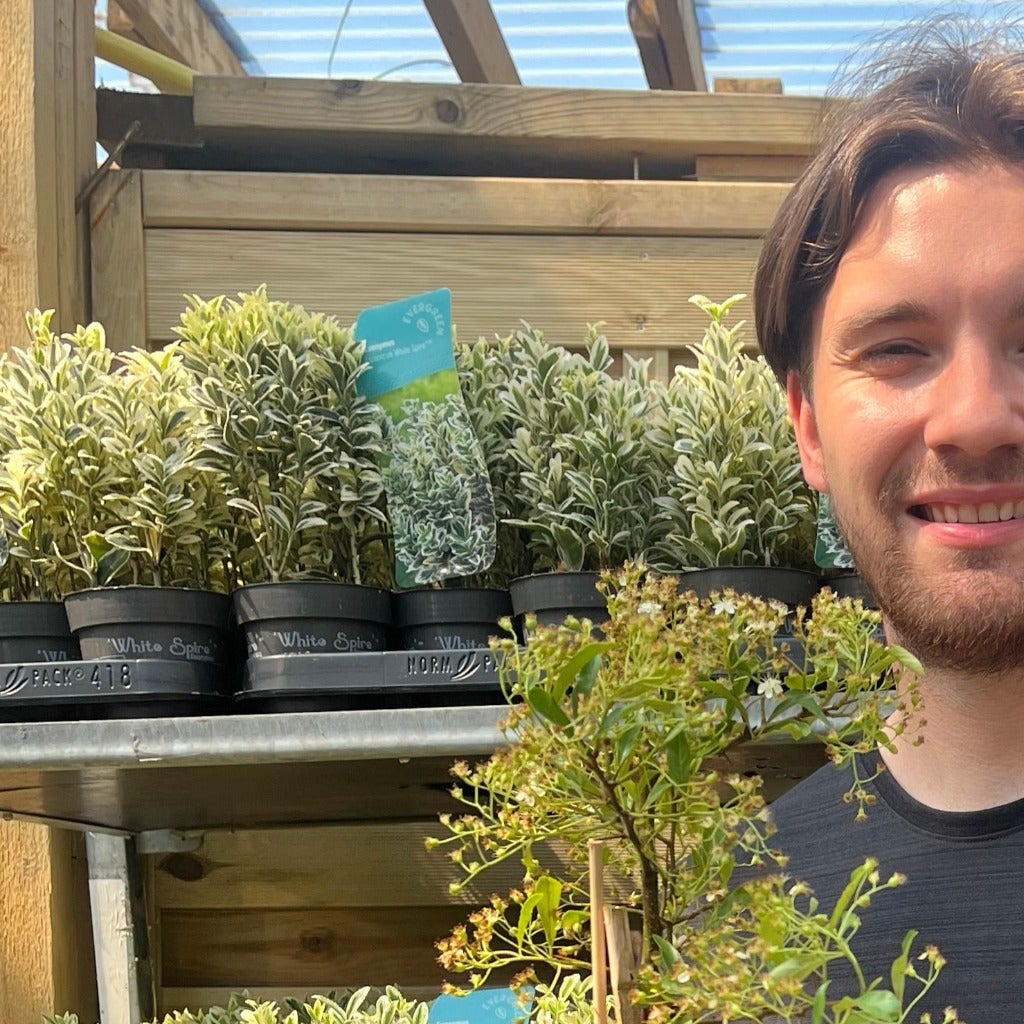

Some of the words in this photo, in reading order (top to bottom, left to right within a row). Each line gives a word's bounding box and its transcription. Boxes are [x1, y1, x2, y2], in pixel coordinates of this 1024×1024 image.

[402, 302, 445, 336] EVERGREEN
[90, 664, 132, 691] 418
[407, 655, 453, 675] NORM
